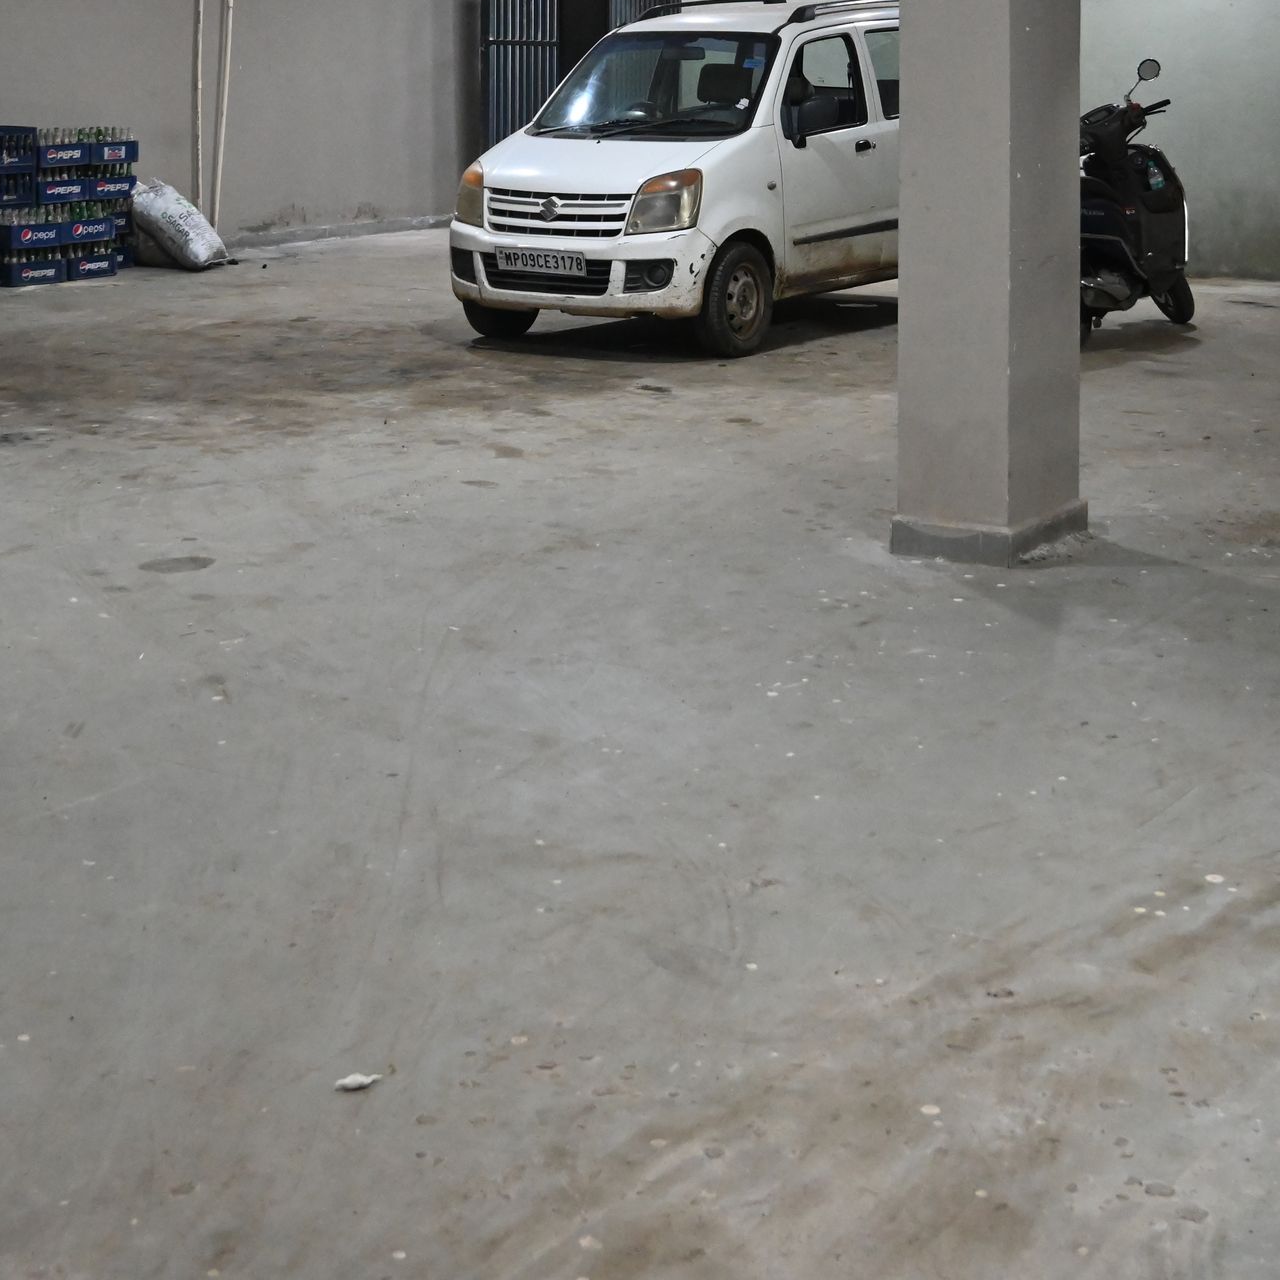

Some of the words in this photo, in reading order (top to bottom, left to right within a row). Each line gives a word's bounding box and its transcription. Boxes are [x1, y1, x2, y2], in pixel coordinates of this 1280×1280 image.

[57, 149, 81, 160] PEPSI
[55, 185, 81, 195] PEPSI
[104, 182, 129, 191] PEPSI
[82, 222, 105, 235] pepsi
[32, 229, 56, 241] pepsi
[86, 261, 109, 270] PEPSI
[504, 252, 583, 271] MP09CE3178
[29, 268, 56, 278] PEPSI
